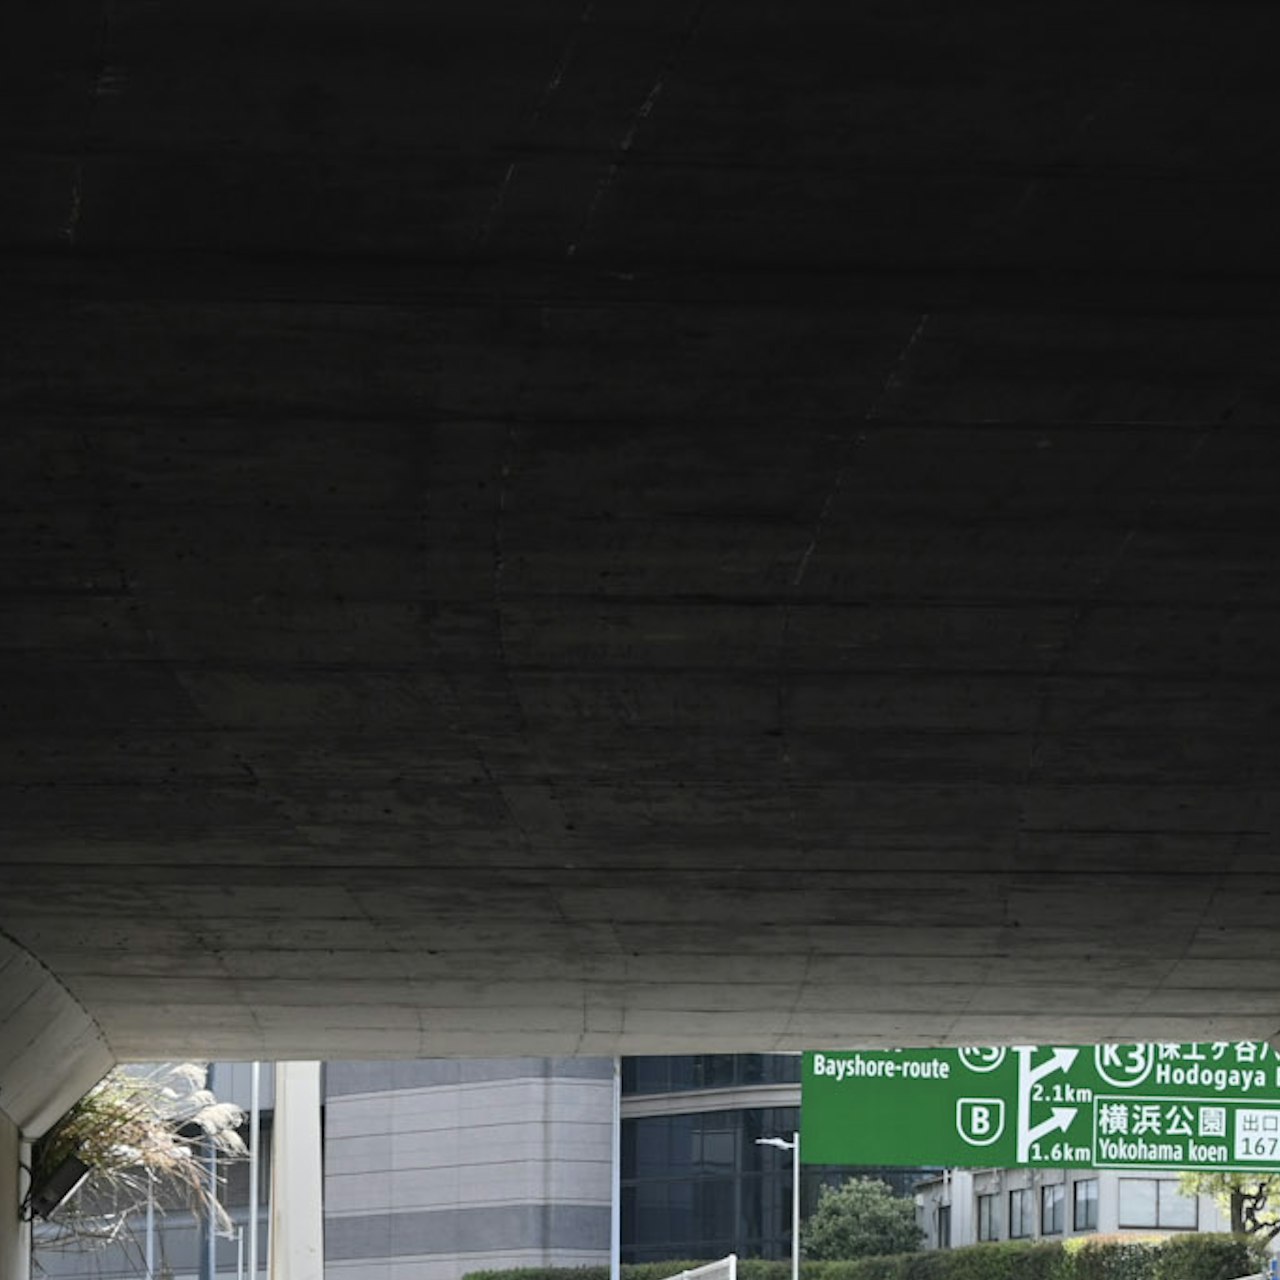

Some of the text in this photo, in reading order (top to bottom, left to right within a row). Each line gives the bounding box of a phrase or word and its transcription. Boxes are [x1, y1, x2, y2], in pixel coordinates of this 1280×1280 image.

[813, 1053, 950, 1081] Bayshore-route
[1103, 1043, 1147, 1074] K3
[1156, 1063, 1266, 1092] Hodogaya
[1032, 1083, 1093, 1104] 2.1km
[971, 1106, 991, 1135] B
[1099, 1103, 1227, 1138] 横浜公園
[1241, 1113, 1280, 1133] 出口
[1031, 1143, 1091, 1163] 1.6km
[1099, 1137, 1228, 1163] Yokohama koen
[1242, 1136, 1279, 1156] 167
